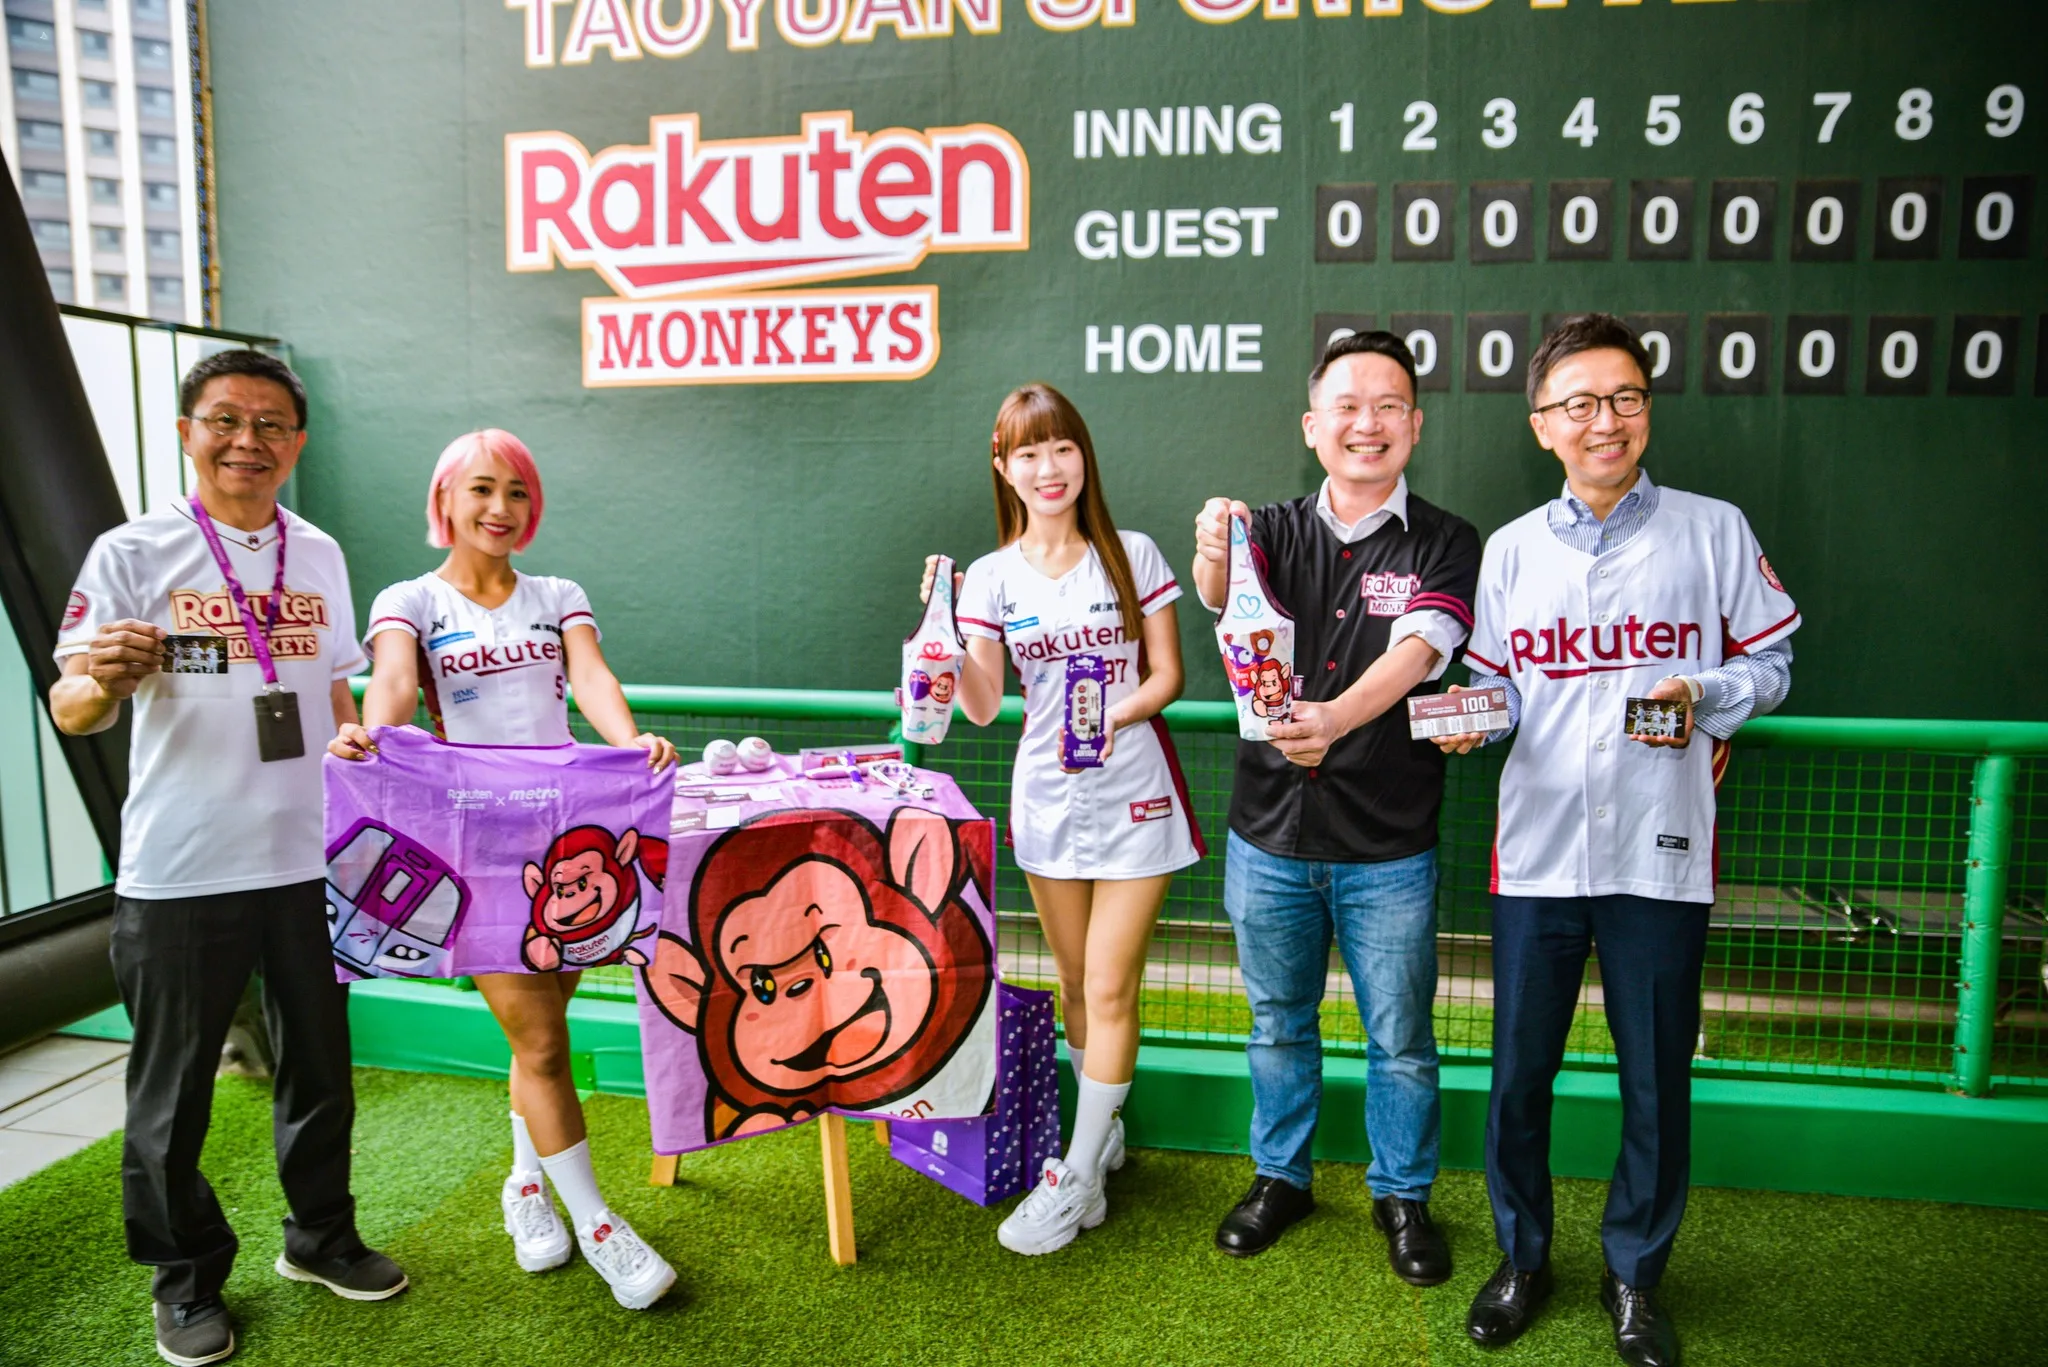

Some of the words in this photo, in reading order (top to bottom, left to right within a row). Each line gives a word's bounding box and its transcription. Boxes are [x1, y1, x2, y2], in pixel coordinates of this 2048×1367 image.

[1074, 104, 1281, 158] INNING
[1331, 103, 1354, 151] 1
[1403, 101, 1437, 150] 2
[1482, 98, 1517, 148] 3
[1563, 97, 1598, 147] 4
[1645, 95, 1681, 145] 5
[1729, 93, 1764, 144] 6
[1813, 92, 1851, 142] 7
[1895, 89, 1933, 140] 8
[1985, 85, 2024, 137] 9
[521, 130, 1014, 254] Rakuten
[1075, 208, 1278, 259] GUEST
[1328, 201, 1362, 247] 0
[1406, 199, 1440, 245] 0
[1484, 200, 1518, 247] 0
[1563, 196, 1598, 244] 0
[1643, 196, 1679, 244] 0
[1724, 196, 1760, 244] 0
[1807, 197, 1844, 245] 0
[1891, 193, 1927, 241] 0
[1976, 193, 2014, 241] 0
[599, 303, 923, 369] MONKEYS
[1086, 325, 1263, 373] HOME
[1479, 330, 1514, 377] 0
[1720, 331, 1756, 379] 0
[1799, 330, 1835, 378] 0
[1881, 331, 1918, 379] 0
[1965, 331, 2002, 379] 0
[228, 634, 317, 660] OKEYS
[1015, 625, 1126, 661] Rakuten
[1510, 615, 1701, 672] Rakuten
[1461, 696, 1489, 713] 100
[447, 788, 493, 800] Rakuten
[508, 787, 560, 801] metro
[567, 934, 610, 955] Rakuten
